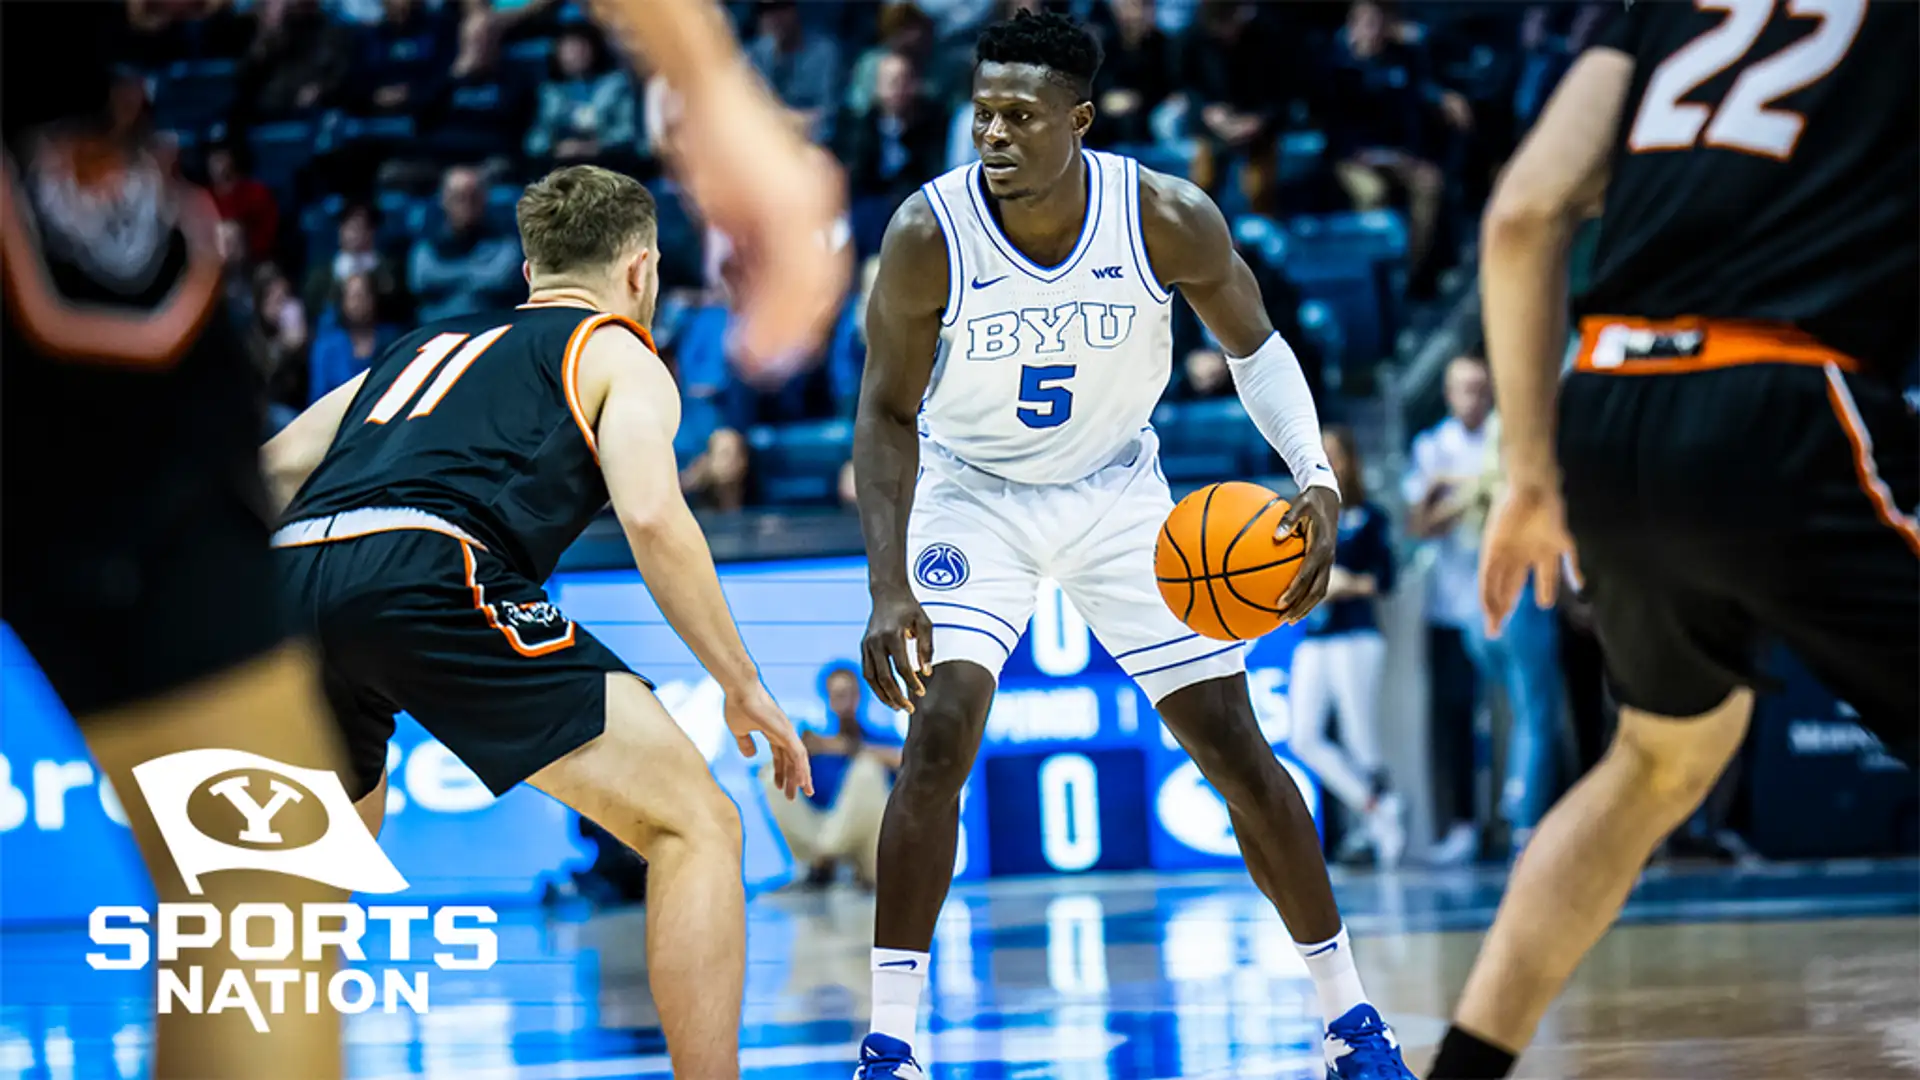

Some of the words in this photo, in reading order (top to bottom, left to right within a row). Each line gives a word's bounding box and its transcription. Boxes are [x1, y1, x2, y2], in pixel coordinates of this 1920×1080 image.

[1628, 0, 1868, 163] 22
[363, 323, 513, 425] 11
[966, 300, 1136, 361] BYU
[1016, 364, 1078, 429] 5
[1038, 752, 1102, 872] 0
